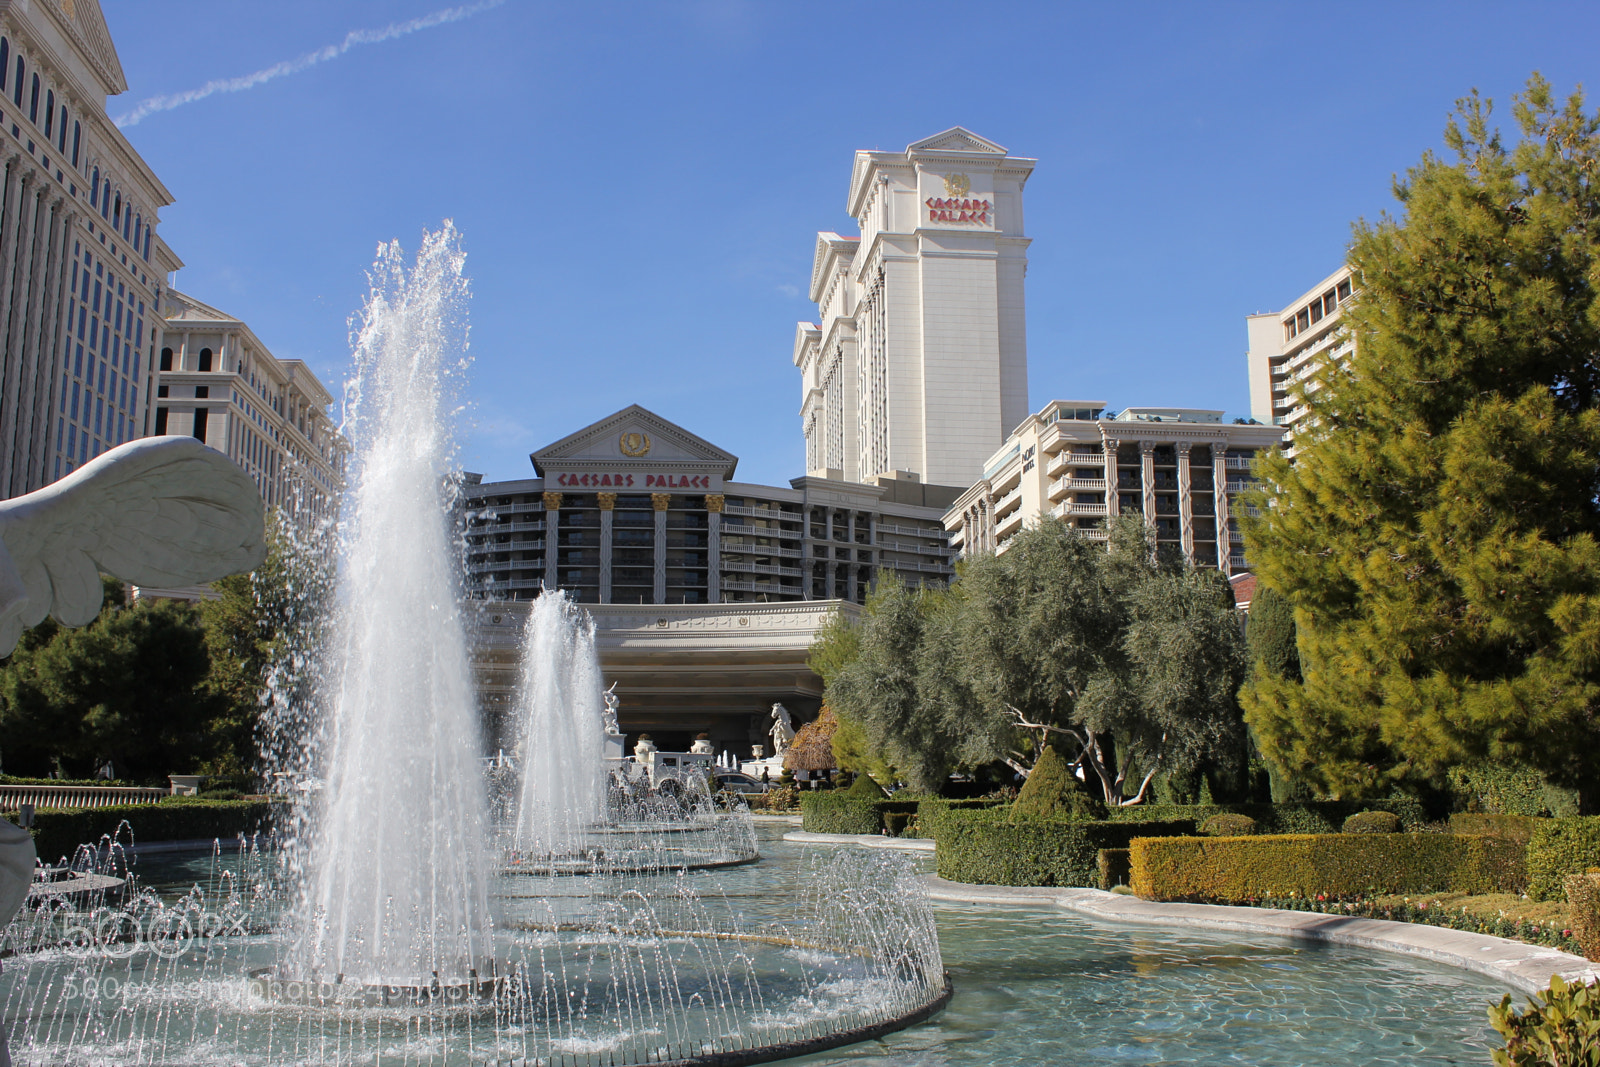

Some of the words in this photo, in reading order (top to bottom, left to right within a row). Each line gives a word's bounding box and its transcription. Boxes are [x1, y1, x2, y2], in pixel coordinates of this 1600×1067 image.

[925, 197, 990, 211] CAESARS
[930, 210, 986, 223] PALACE
[557, 473, 635, 487] CAESARS
[645, 474, 710, 488] PALACE
